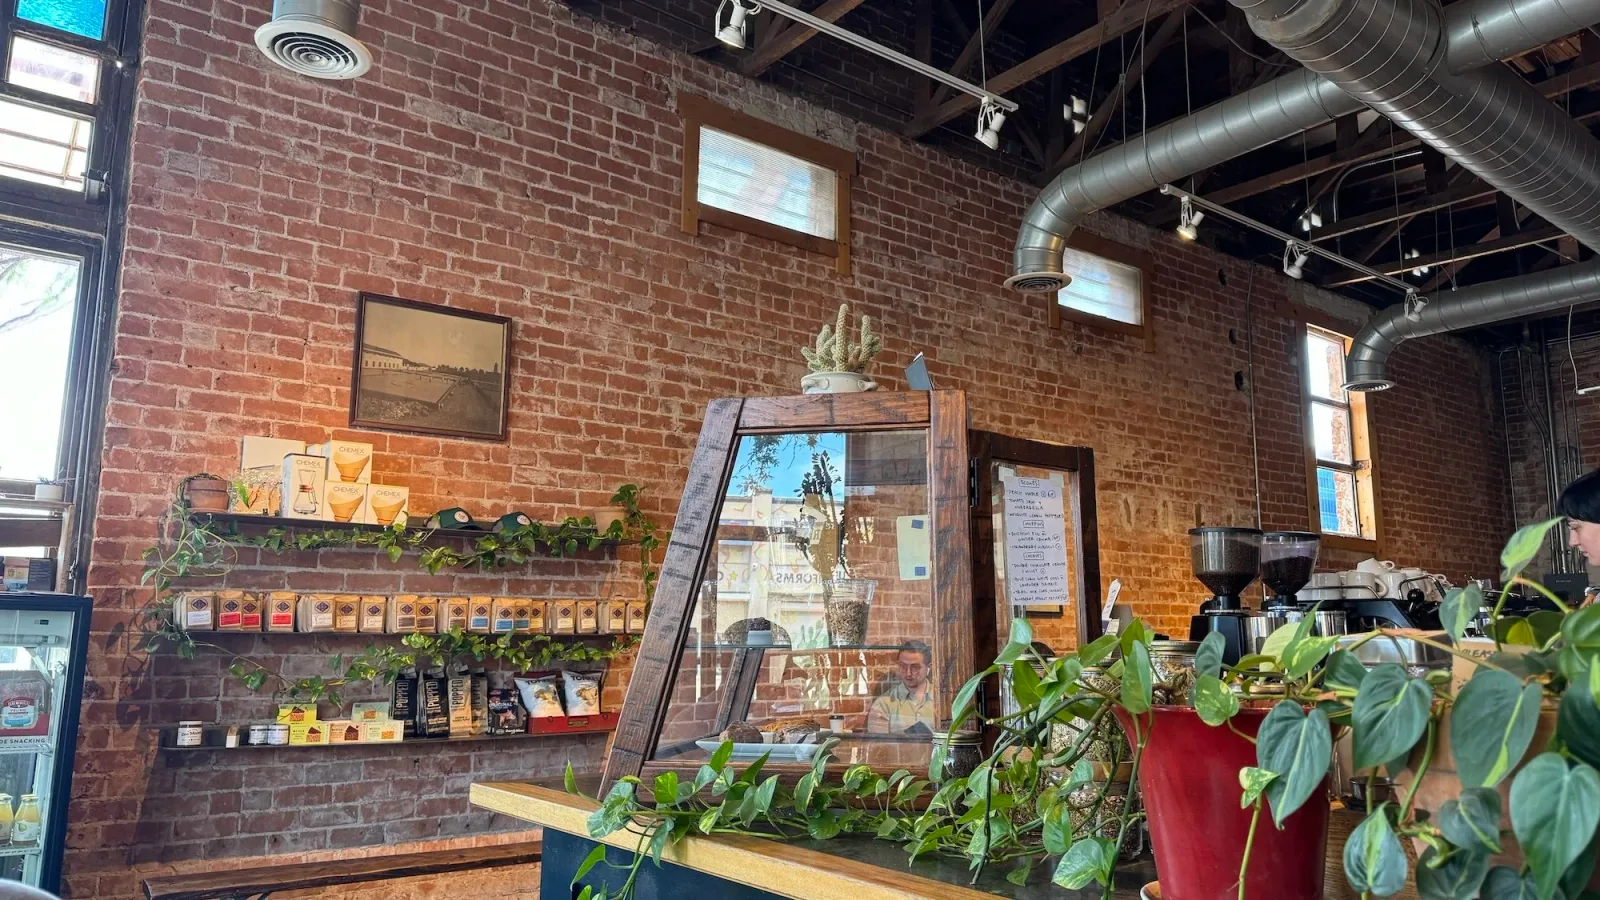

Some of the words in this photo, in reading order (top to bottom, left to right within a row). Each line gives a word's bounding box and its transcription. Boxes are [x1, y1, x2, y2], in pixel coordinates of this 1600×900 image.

[338, 446, 364, 454] CHEMEX
[296, 459, 320, 467] CHEMEX
[333, 486, 359, 494] CHEMEX
[376, 490, 401, 498] CHEMEX
[1462, 648, 1496, 658] PLEAS
